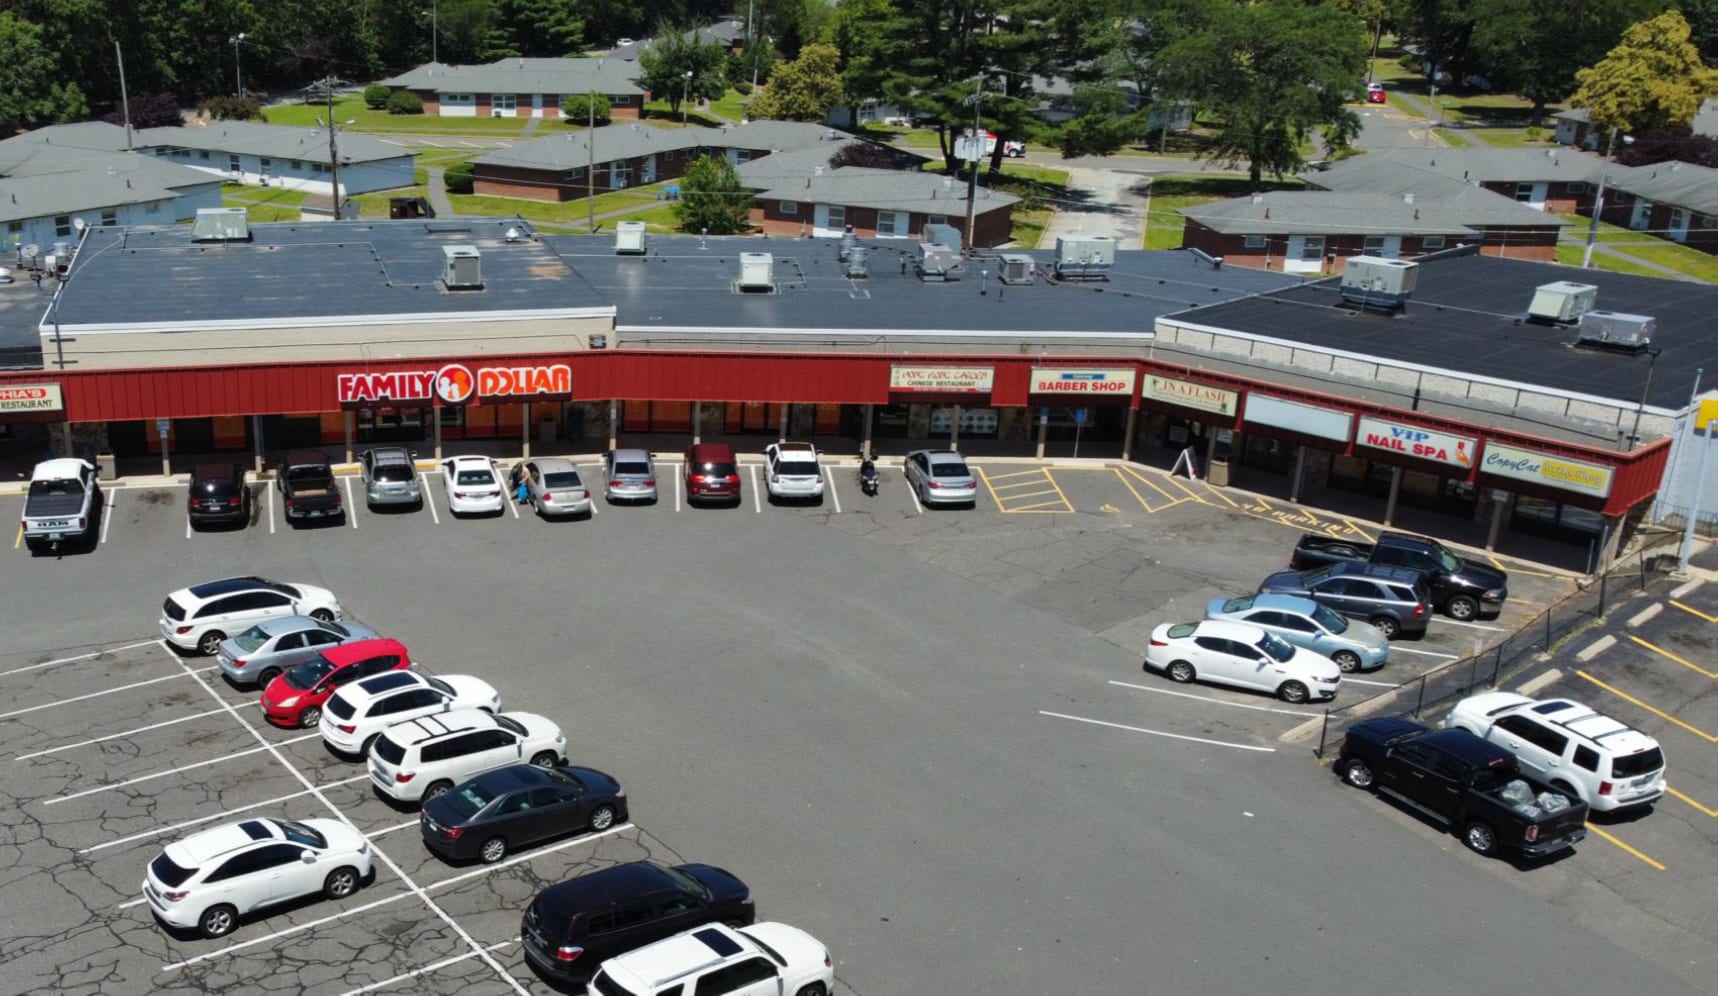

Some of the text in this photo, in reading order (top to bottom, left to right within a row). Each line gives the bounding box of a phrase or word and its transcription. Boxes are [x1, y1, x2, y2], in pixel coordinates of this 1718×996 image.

[338, 364, 571, 402] FAMILY DOLLAR
[1038, 381, 1126, 391] BARBER SHOP
[0, 389, 41, 399] HIA'S
[1187, 385, 1227, 403] FLASH
[1, 399, 52, 409] RESTAURANT
[1391, 426, 1430, 441] VIP
[1367, 433, 1448, 460] NAIL SPA
[1272, 510, 1356, 535] PARKING
